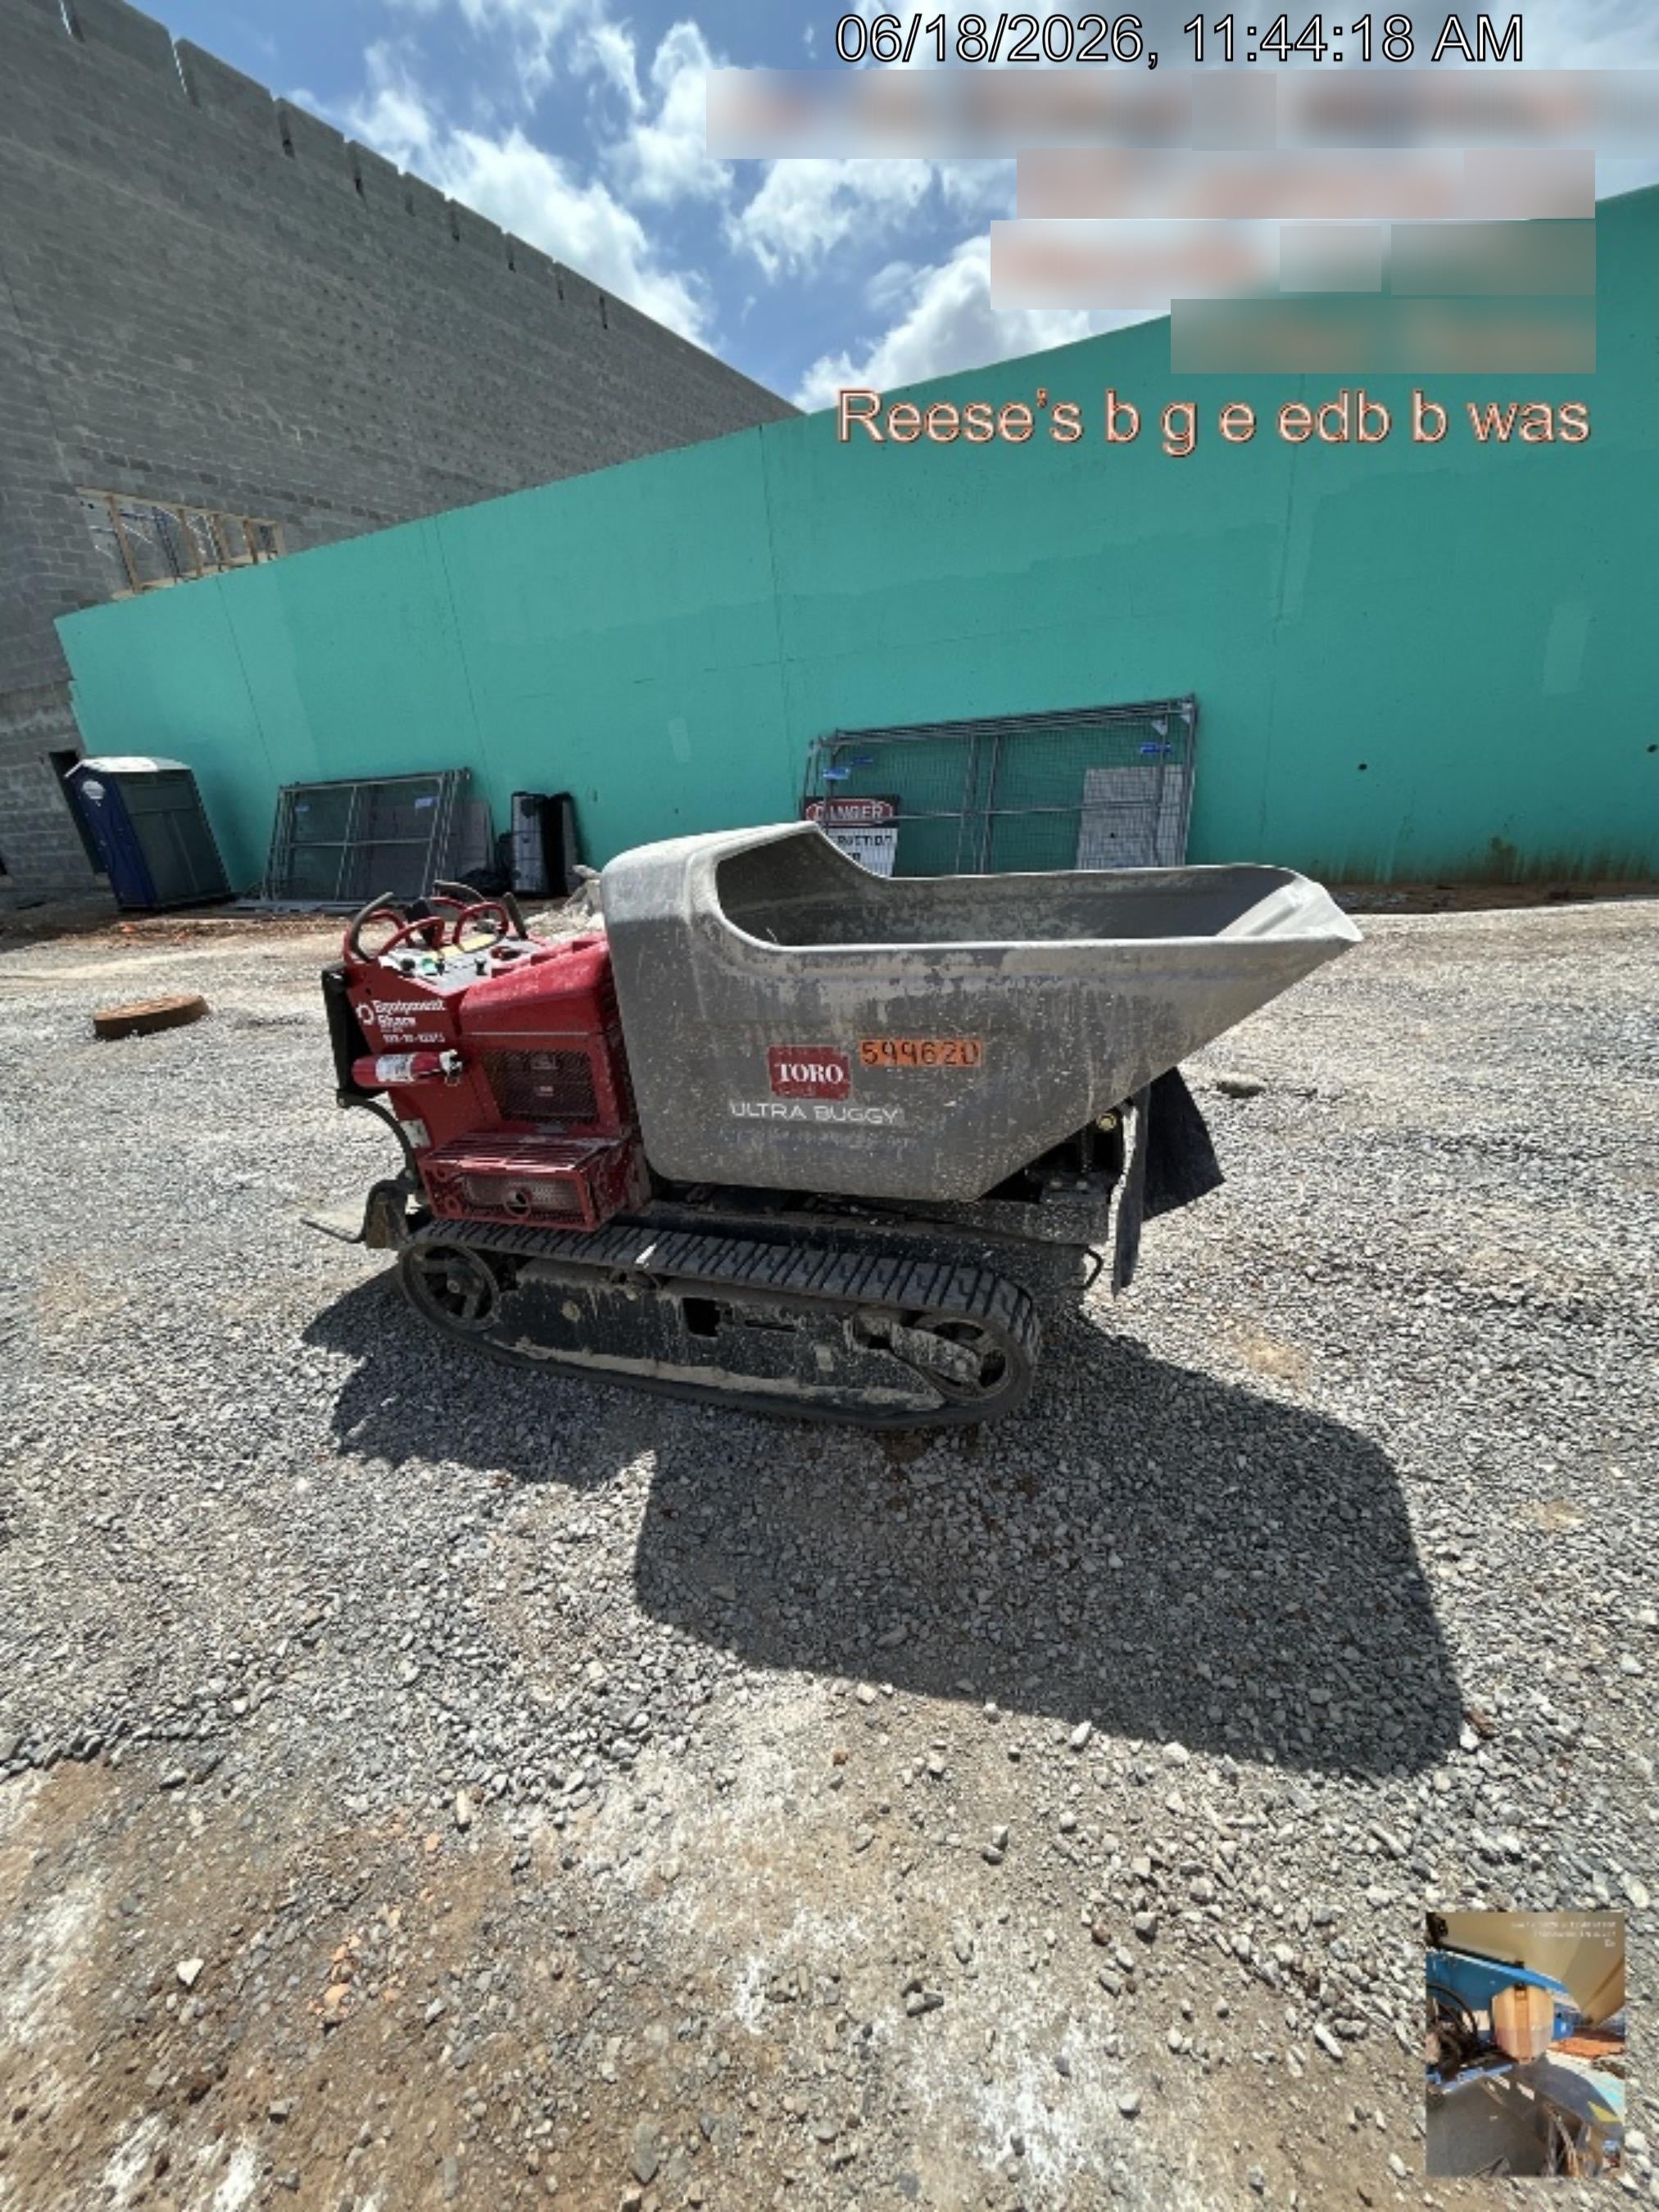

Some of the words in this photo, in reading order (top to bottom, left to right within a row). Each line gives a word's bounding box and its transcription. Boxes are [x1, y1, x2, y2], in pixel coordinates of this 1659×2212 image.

[781, 1064, 844, 1084] TORO
[731, 1102, 807, 1121] ULTRA
[814, 1105, 899, 1125] BUGGY
